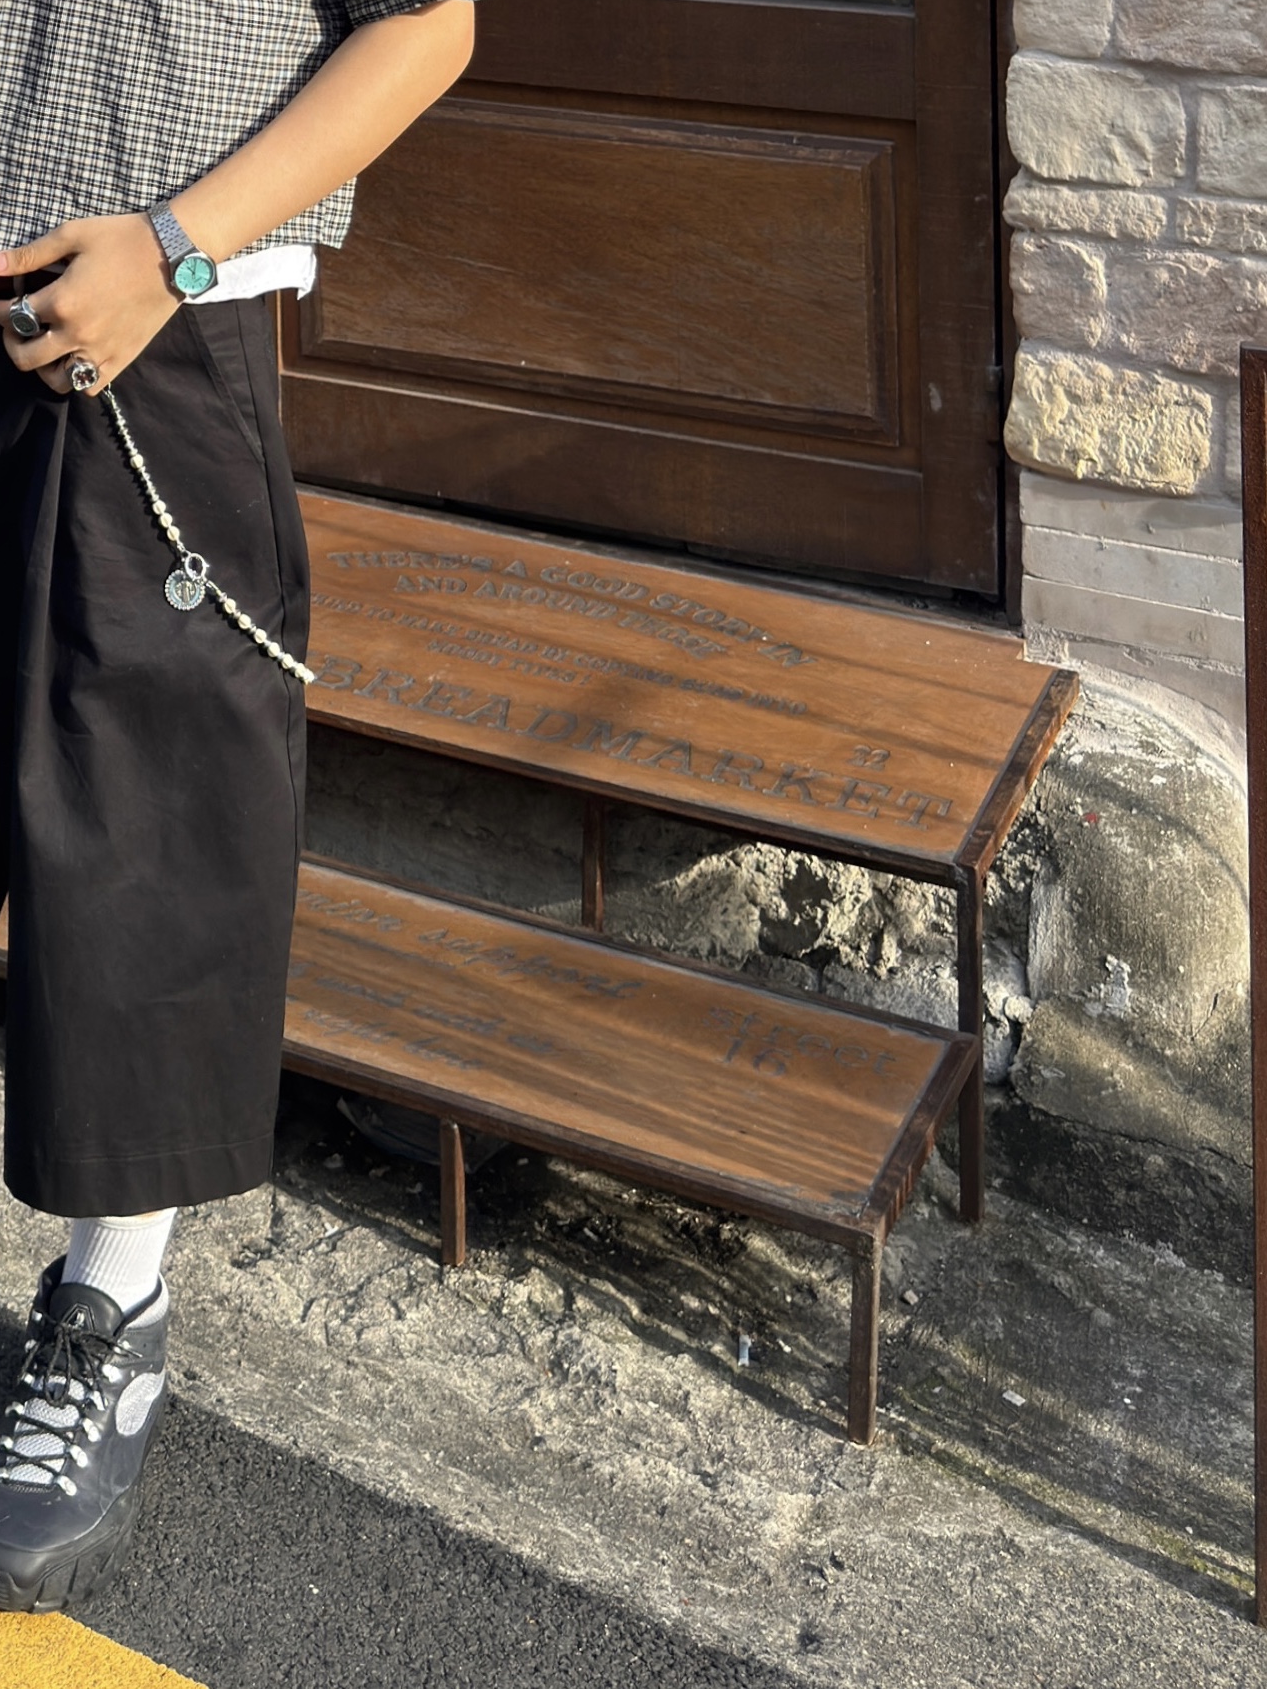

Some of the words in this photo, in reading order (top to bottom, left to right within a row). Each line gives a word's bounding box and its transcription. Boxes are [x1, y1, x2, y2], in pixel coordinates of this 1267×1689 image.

[327, 550, 493, 573] THERE'S
[500, 559, 529, 579] A
[539, 565, 650, 600] GOOD
[649, 592, 773, 644] STORY
[756, 641, 819, 669] IN
[392, 574, 468, 595] AND
[473, 579, 619, 620] AROUND
[701, 1006, 898, 1078] street
[723, 1034, 793, 1077] 16
